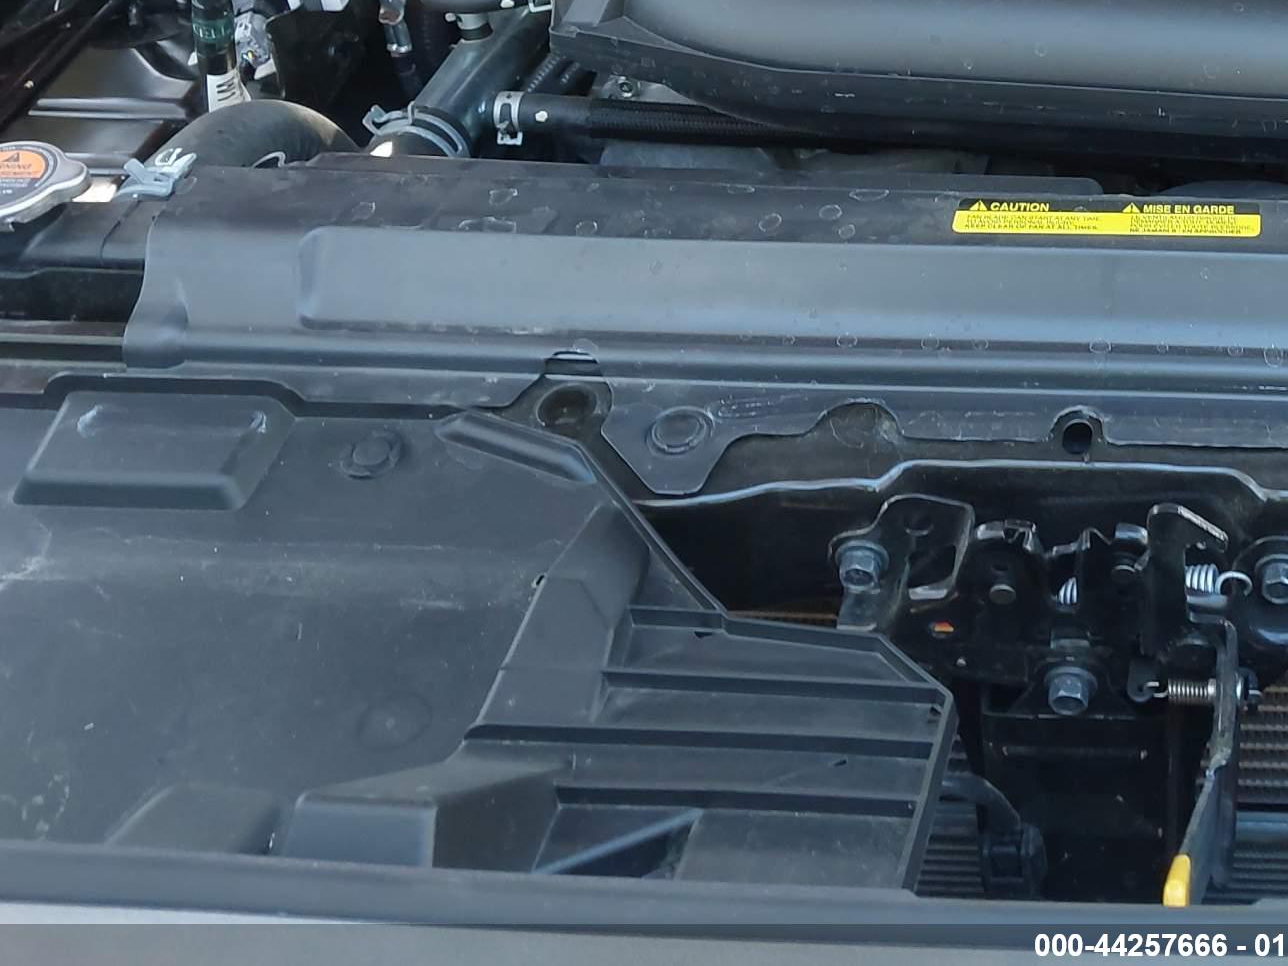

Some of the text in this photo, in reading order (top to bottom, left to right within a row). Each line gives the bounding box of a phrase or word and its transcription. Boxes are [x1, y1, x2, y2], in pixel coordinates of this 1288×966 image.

[990, 202, 1050, 212] CAUTION
[1143, 204, 1235, 215] MISE EN GARDE
